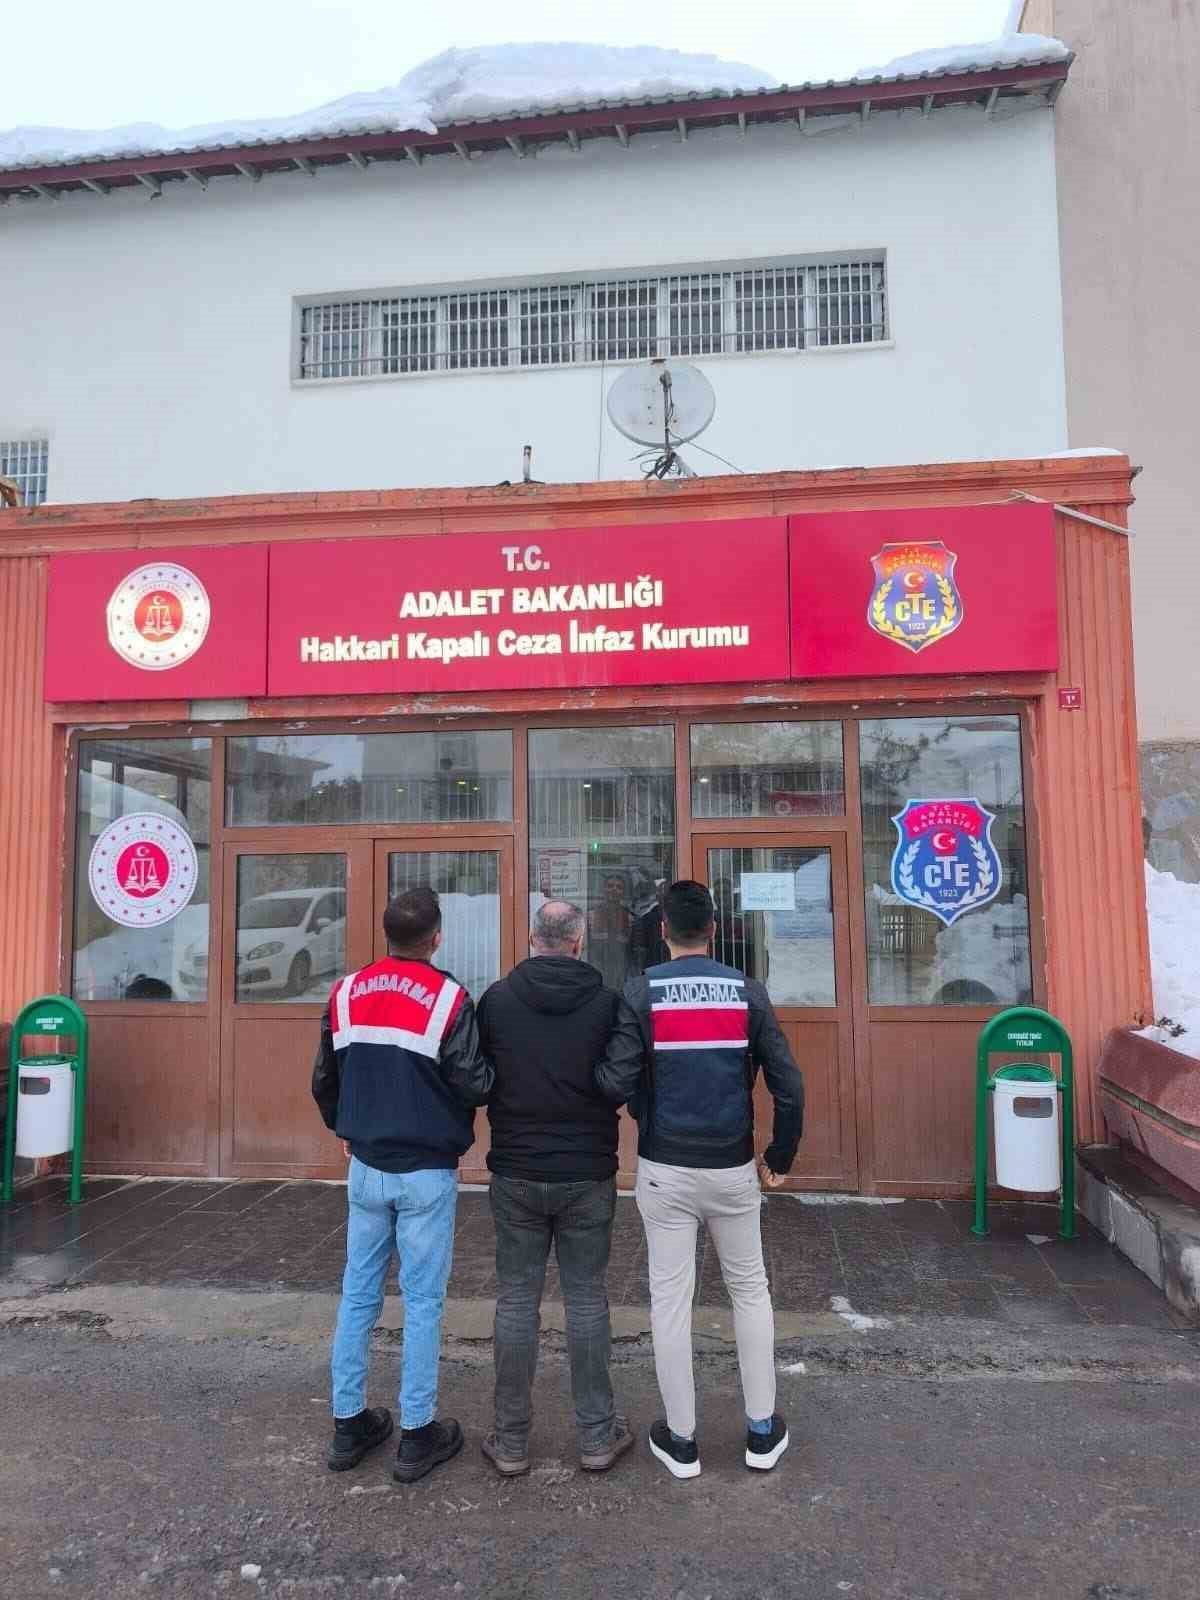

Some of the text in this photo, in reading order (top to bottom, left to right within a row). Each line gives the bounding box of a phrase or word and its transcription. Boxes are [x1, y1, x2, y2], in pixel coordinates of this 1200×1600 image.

[501, 546, 551, 572] T.C.
[399, 575, 664, 619] ADALET BAKANLIĞI
[895, 592, 937, 622] CTE
[300, 619, 750, 665] Hakkari Kapalı Ceza İnfaz Kurumu
[924, 855, 970, 888] CTE
[350, 973, 437, 1010] JANDARMA
[661, 983, 740, 1002] JANDARMA
